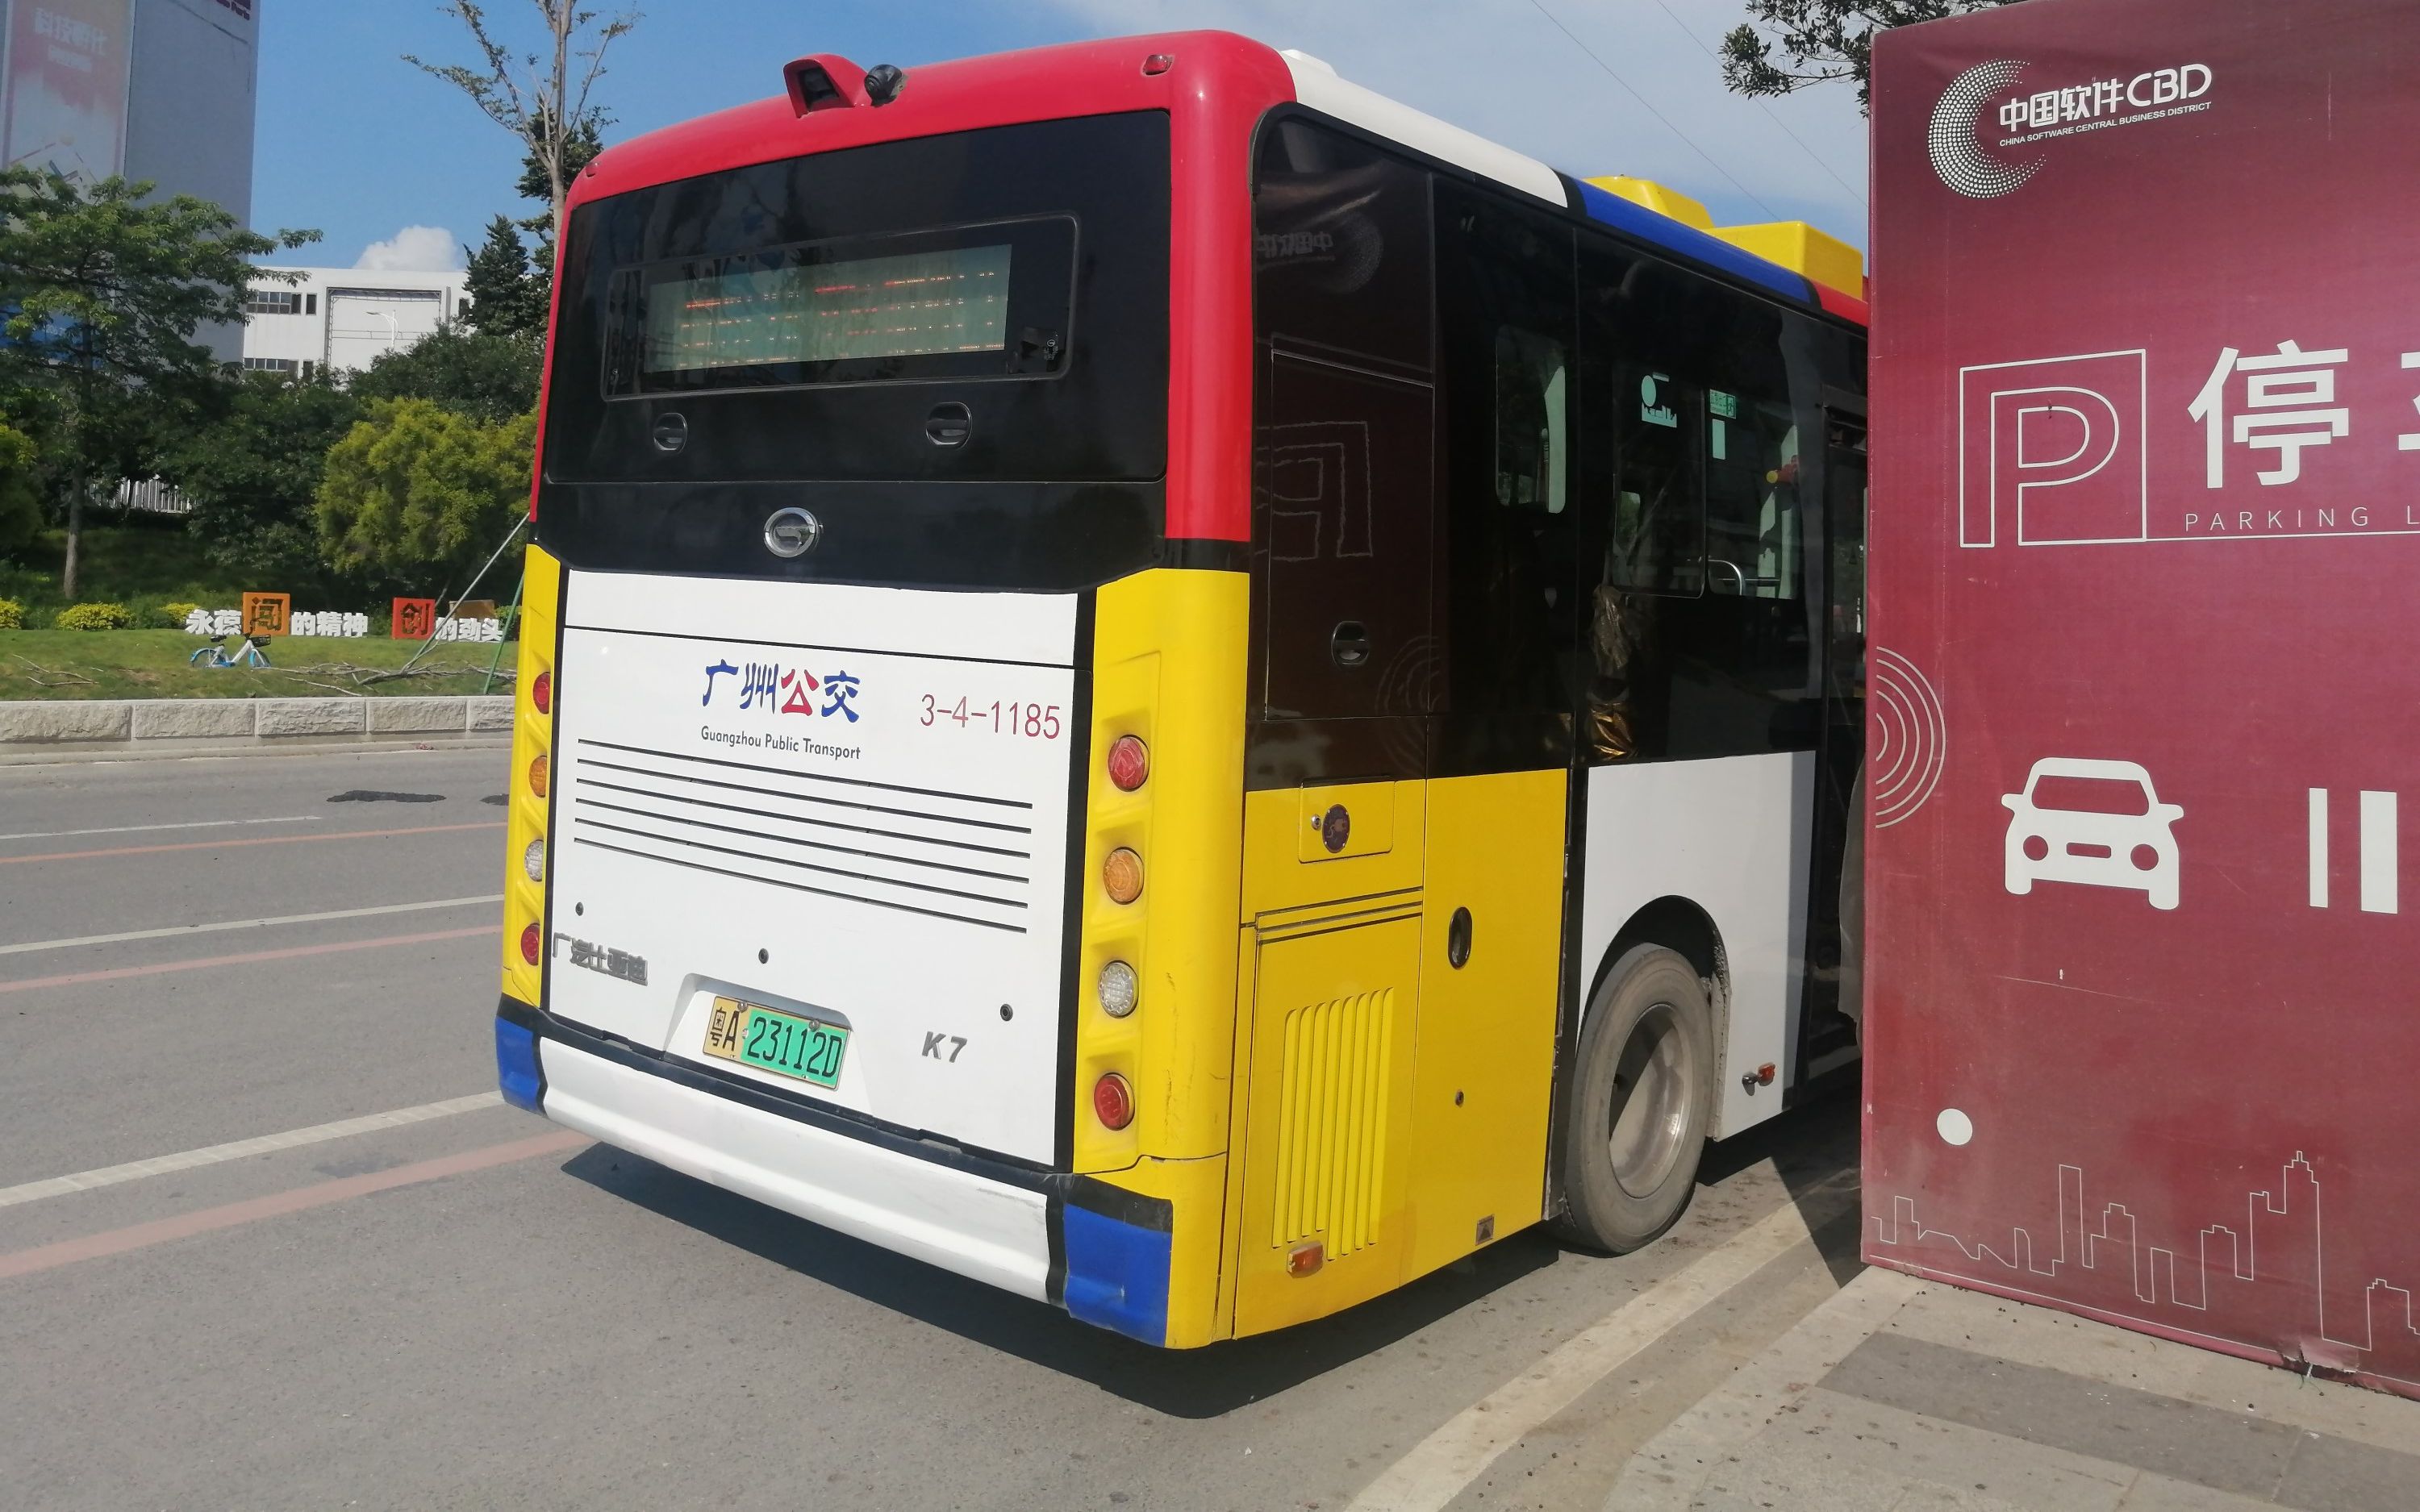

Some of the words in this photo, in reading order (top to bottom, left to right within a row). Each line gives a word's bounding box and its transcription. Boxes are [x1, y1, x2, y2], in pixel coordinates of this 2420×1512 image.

[2000, 136, 2026, 147] CHINA
[2027, 127, 2074, 142] SOFTWARE
[2076, 119, 2118, 134] CENTRAL
[2119, 110, 2166, 125] BUSINESS
[2168, 102, 2212, 116] DISTRICT
[2185, 506, 2369, 532] PARKING
[703, 659, 861, 723] 广州公交
[920, 694, 1061, 739] 3-4-1185
[701, 725, 761, 748] Guangzhou
[765, 733, 799, 753] Public
[803, 737, 862, 761] Transport
